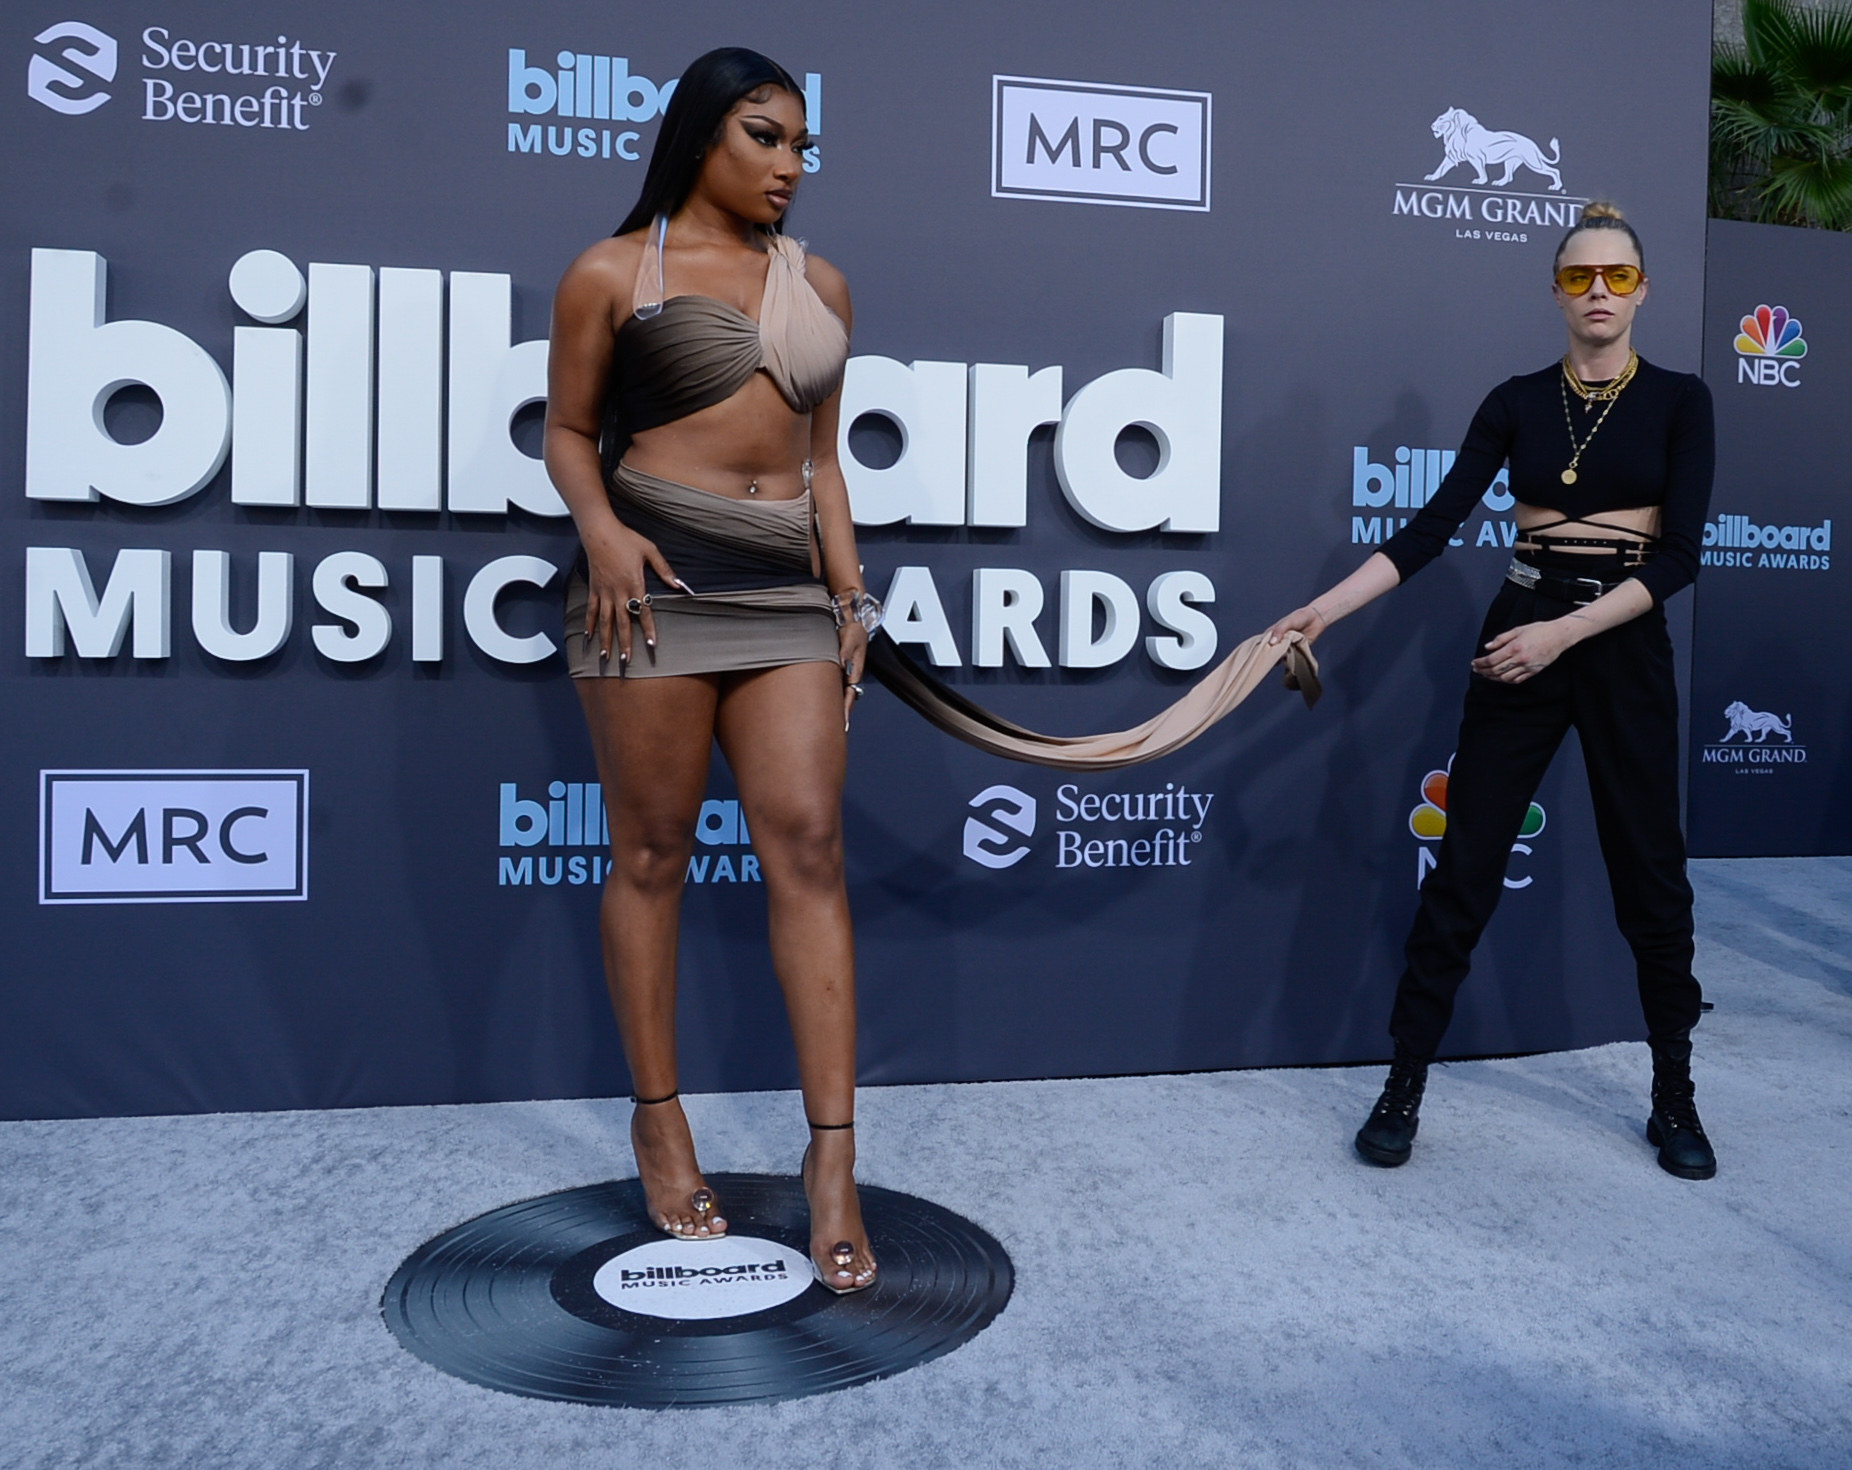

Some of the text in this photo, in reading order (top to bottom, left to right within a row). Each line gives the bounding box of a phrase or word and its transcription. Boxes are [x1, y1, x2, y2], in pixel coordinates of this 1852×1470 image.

[142, 26, 337, 90] Security
[507, 123, 640, 161] MUSIC
[1026, 112, 1180, 175] MRC
[1392, 189, 1473, 220] MGM
[1455, 229, 1528, 243] LAS VEGAS
[1737, 357, 1801, 387] NBC
[25, 247, 1225, 534] billbard
[1700, 551, 1831, 571] MUSIC AWARDS
[25, 546, 1219, 671] MUSIC ARDS
[1702, 748, 1807, 763] MGM GRAND
[1056, 783, 1214, 829] Security
[80, 806, 270, 866] MRC
[620, 1259, 786, 1282] billboard
[621, 1273, 789, 1290] MUSIC AWARDS
